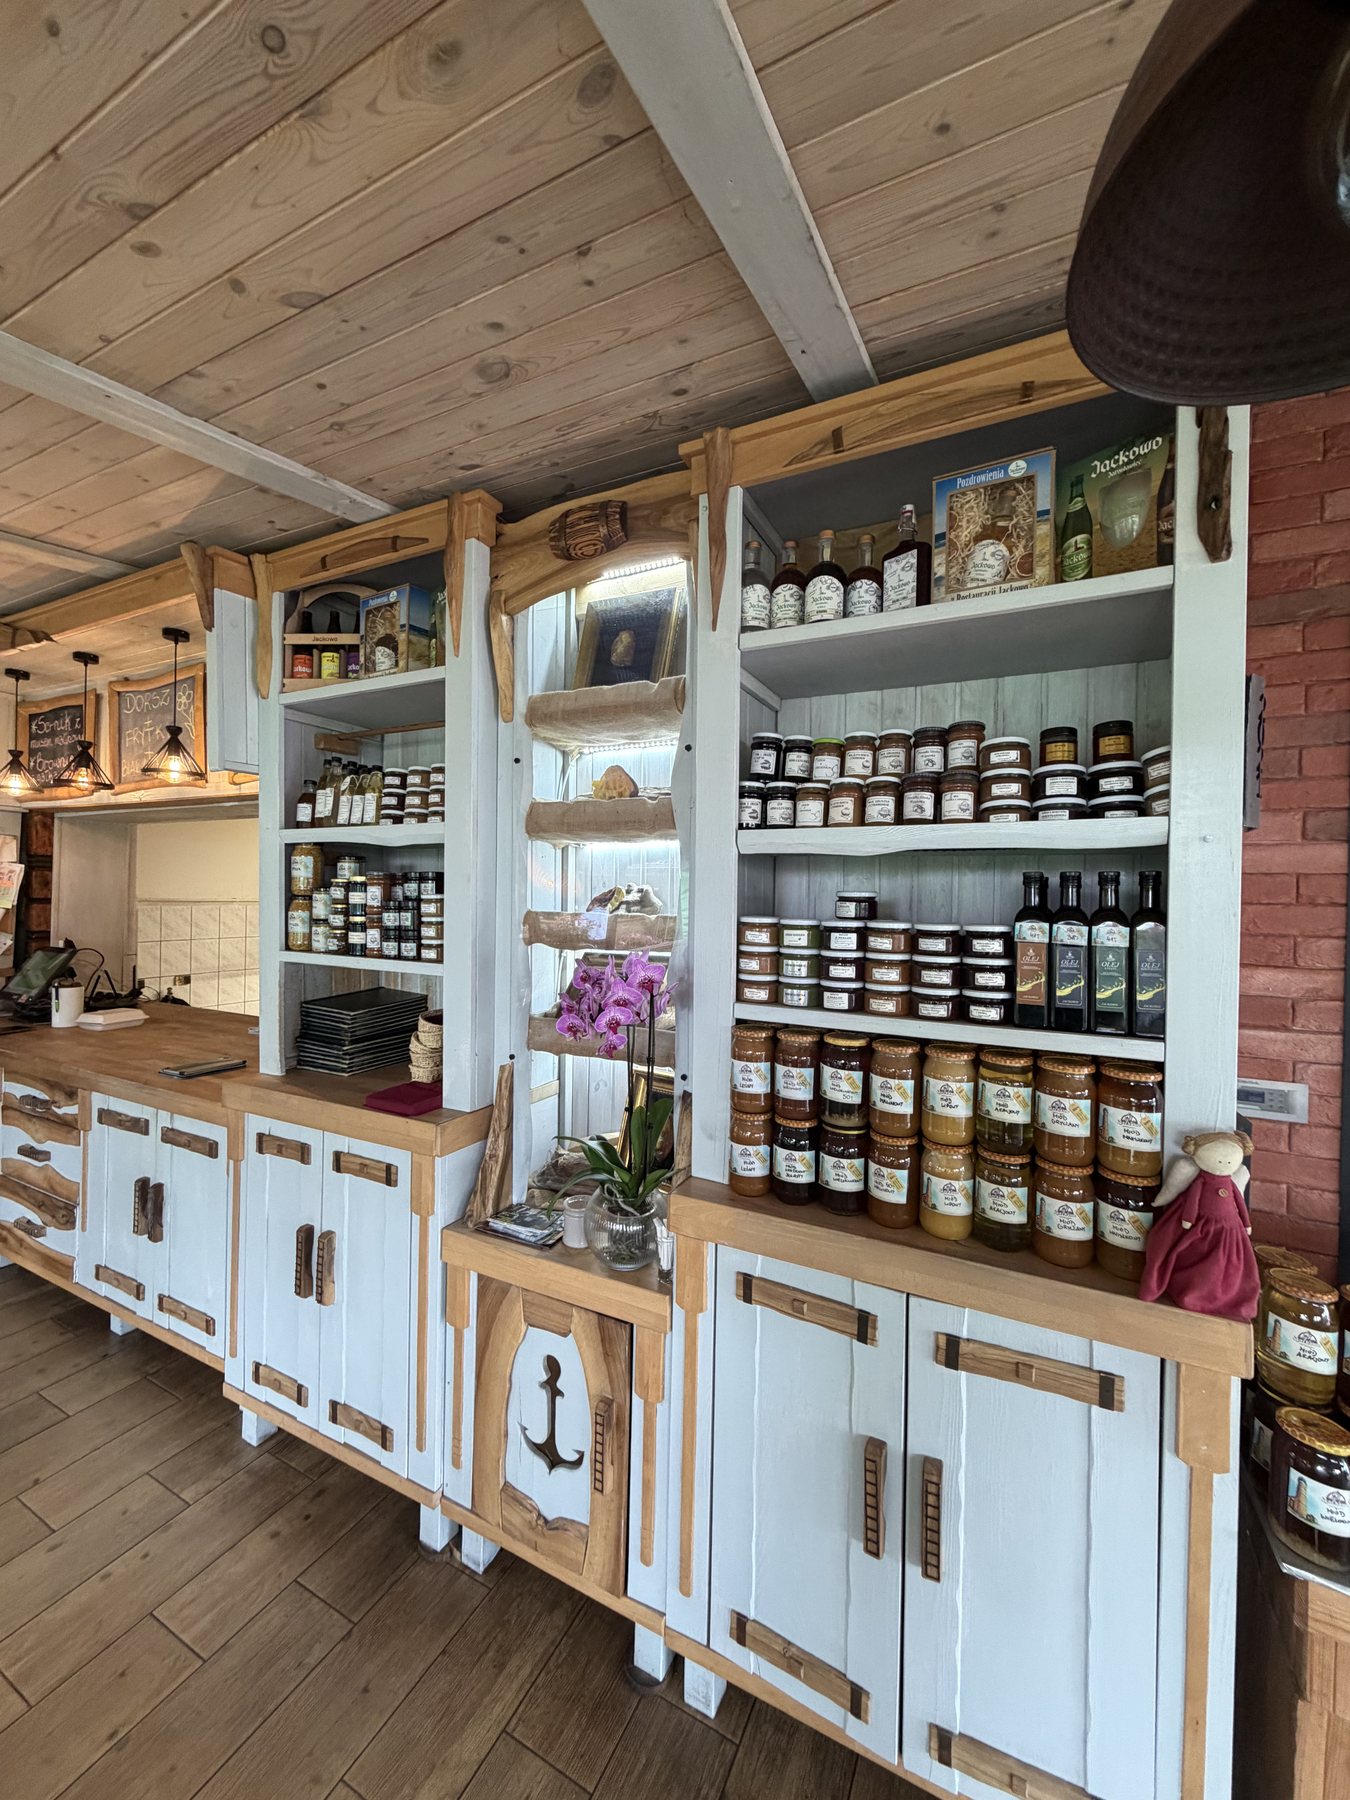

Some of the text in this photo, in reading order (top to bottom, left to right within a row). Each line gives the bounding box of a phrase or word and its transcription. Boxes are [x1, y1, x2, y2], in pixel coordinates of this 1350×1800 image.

[1090, 437, 1162, 478] Jackowo
[956, 468, 1005, 489] Pozdrowienia
[123, 689, 170, 714] DORSZ
